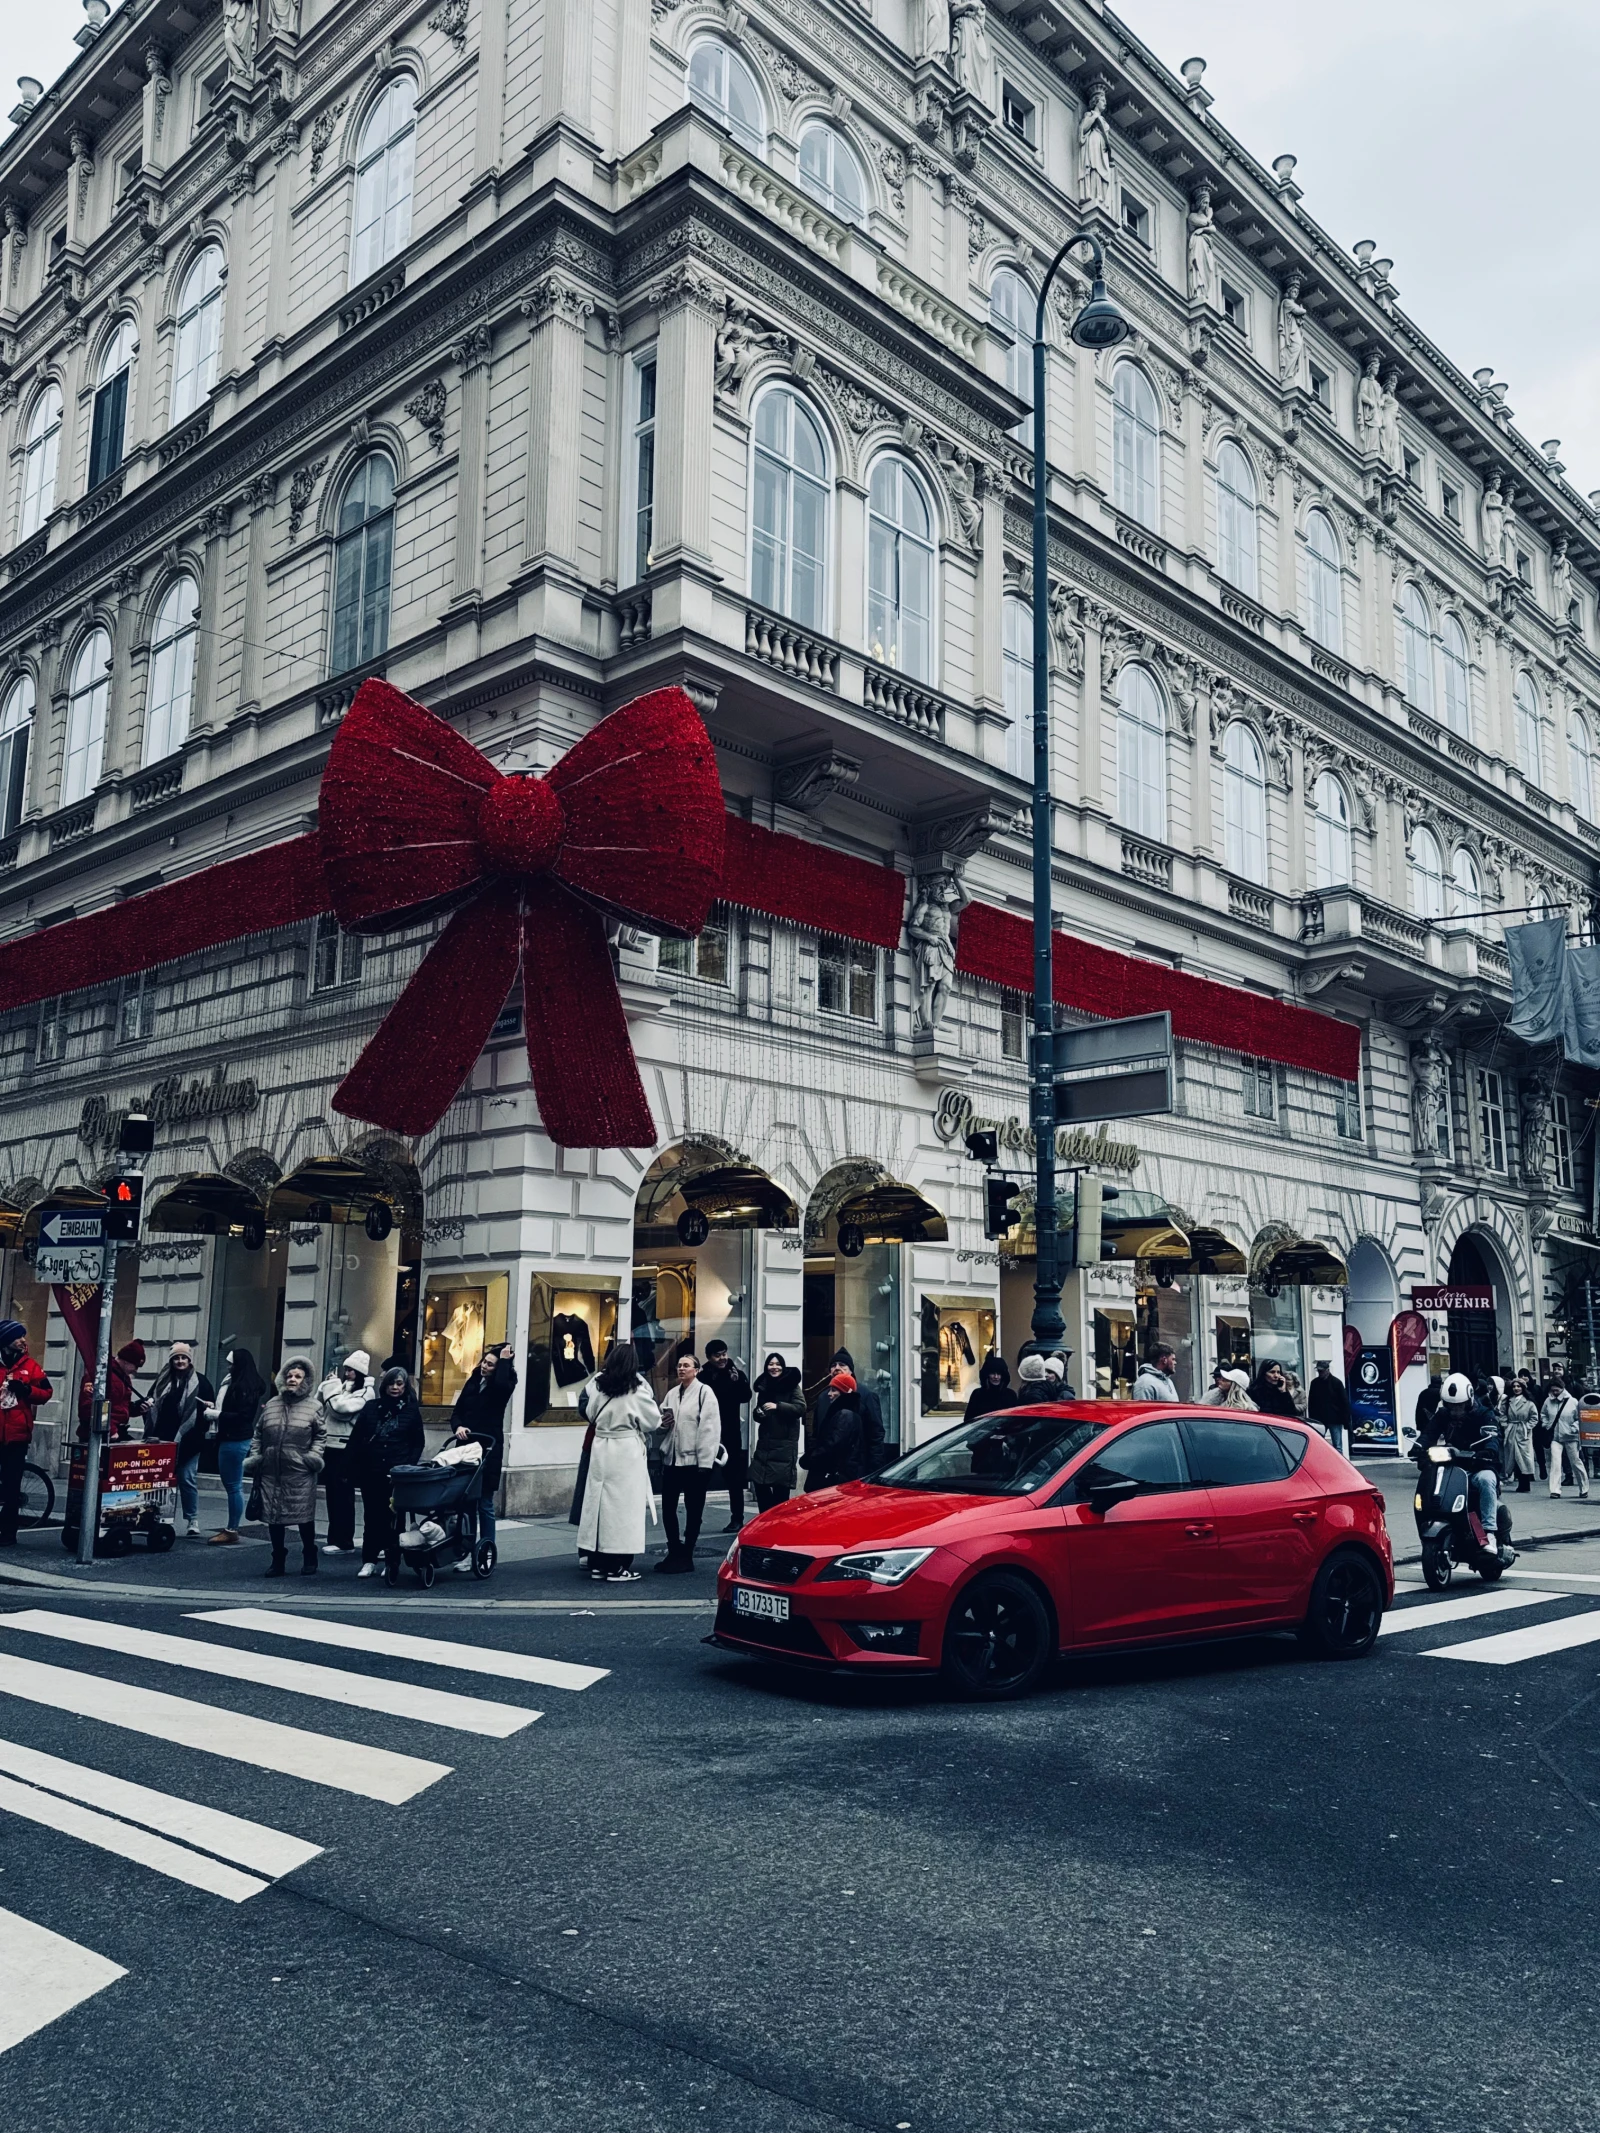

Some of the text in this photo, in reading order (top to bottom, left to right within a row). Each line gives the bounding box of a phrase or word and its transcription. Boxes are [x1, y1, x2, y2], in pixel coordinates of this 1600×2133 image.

[1022, 1122, 1141, 1170] retschmer
[1415, 1298, 1490, 1308] SOUVENIR
[113, 1458, 171, 1469] HOP-ON HOP-OFF
[125, 1481, 151, 1490] TICKETS
[738, 1591, 787, 1617] CB 1733 TE
